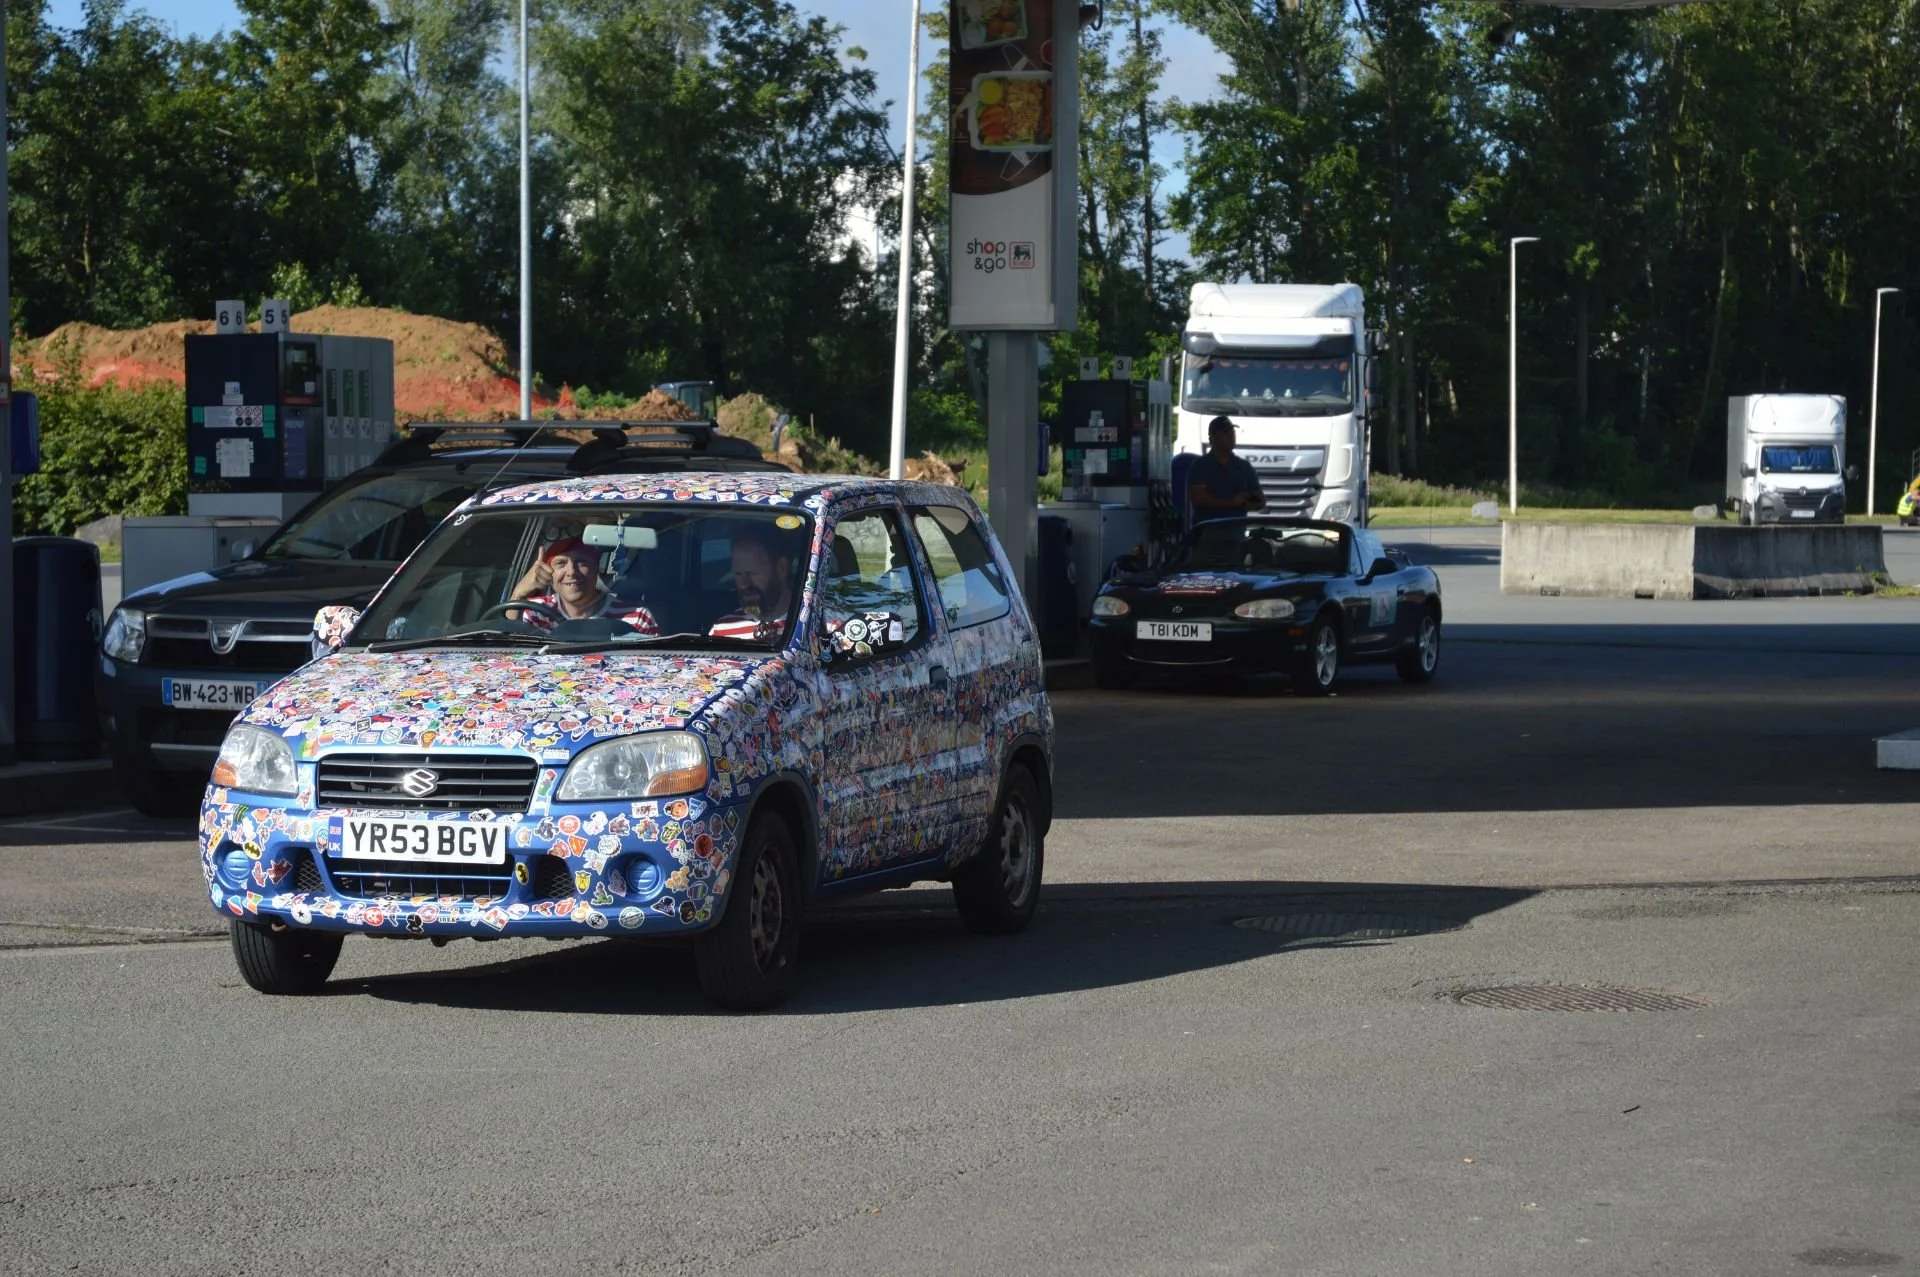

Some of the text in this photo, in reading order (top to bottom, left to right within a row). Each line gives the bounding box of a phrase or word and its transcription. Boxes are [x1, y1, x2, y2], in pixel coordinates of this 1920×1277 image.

[966, 237, 1006, 256] shop
[974, 257, 1006, 273] &go
[219, 310, 229, 326] 6
[235, 310, 243, 326] 6
[265, 308, 274, 325] 5
[281, 309, 288, 325] 5
[1083, 360, 1090, 371] 4
[1116, 360, 1124, 371] 3
[1245, 455, 1286, 463] DAF
[1149, 623, 1199, 638] T81 KDM
[172, 682, 255, 704] BW-423-WB
[328, 841, 341, 852] UK
[349, 821, 498, 858] YR53 BGV
